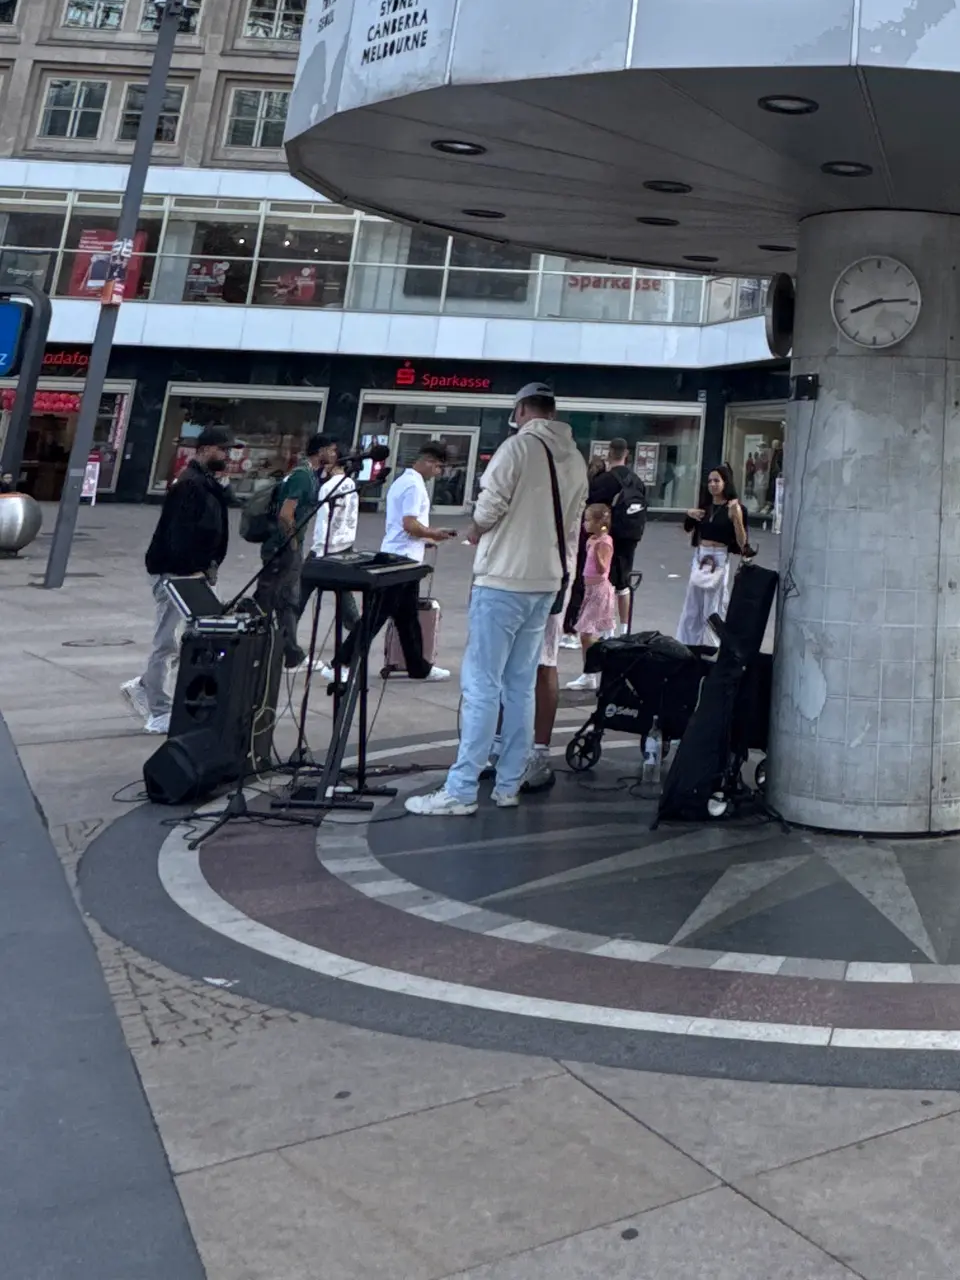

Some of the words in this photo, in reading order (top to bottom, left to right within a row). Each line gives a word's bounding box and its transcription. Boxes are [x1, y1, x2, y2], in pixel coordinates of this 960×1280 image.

[367, 9, 428, 42] CANBERRA
[360, 30, 429, 66] MELBOURNE
[41, 351, 89, 366] odafo
[422, 373, 490, 389] Sparkasse
